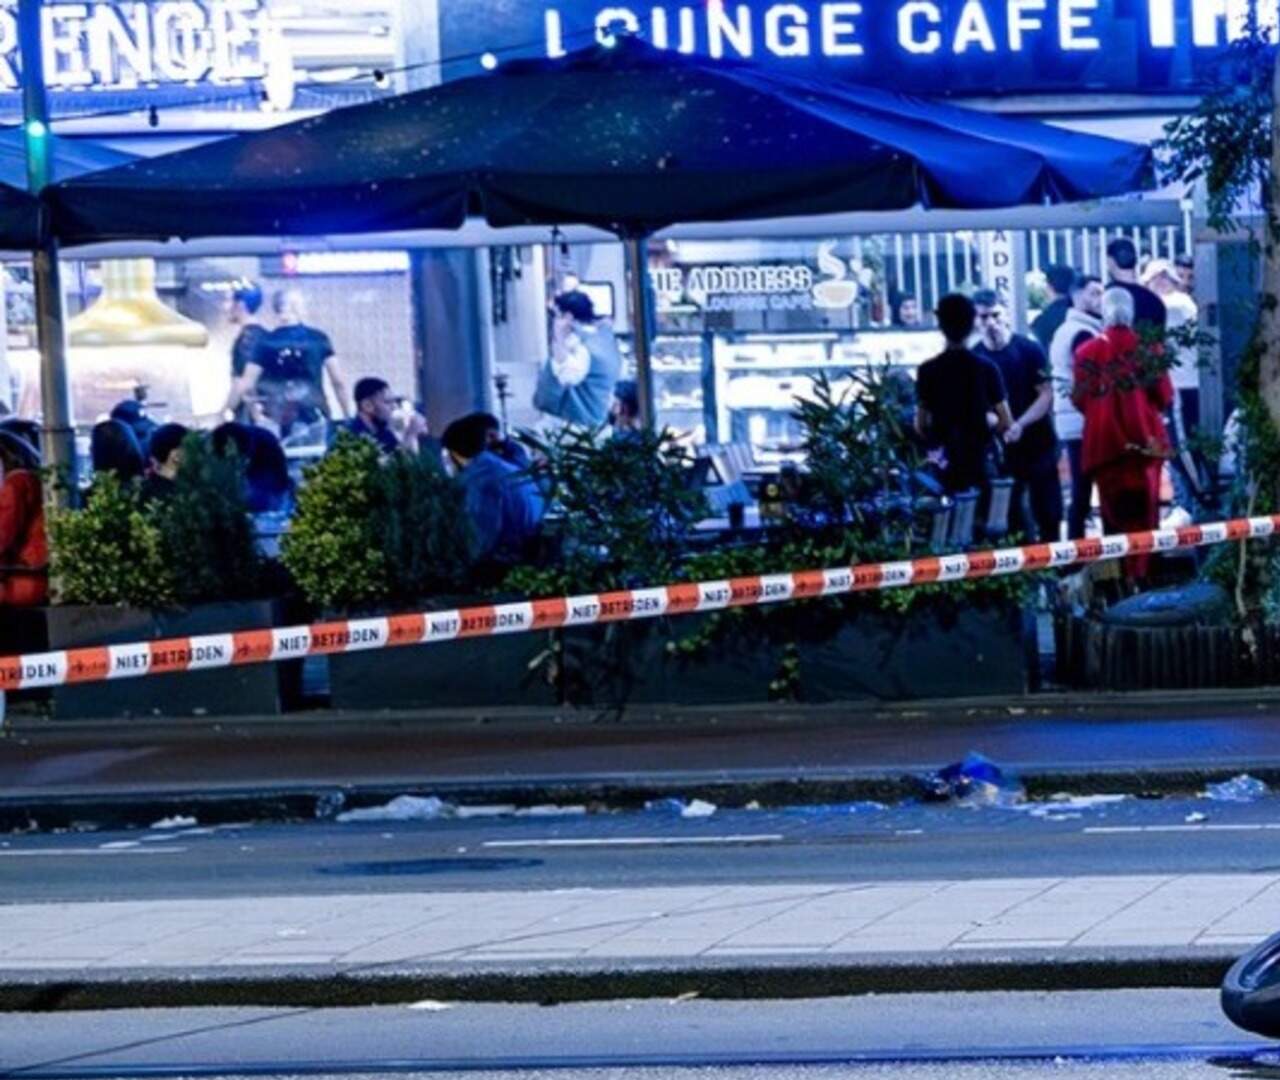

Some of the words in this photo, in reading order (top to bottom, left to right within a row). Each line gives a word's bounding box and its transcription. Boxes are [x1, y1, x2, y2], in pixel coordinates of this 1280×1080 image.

[545, 0, 864, 59] LOUNGE
[688, 265, 812, 293] ADDRESS
[116, 653, 148, 669] NIET
[279, 635, 309, 651] NIET
